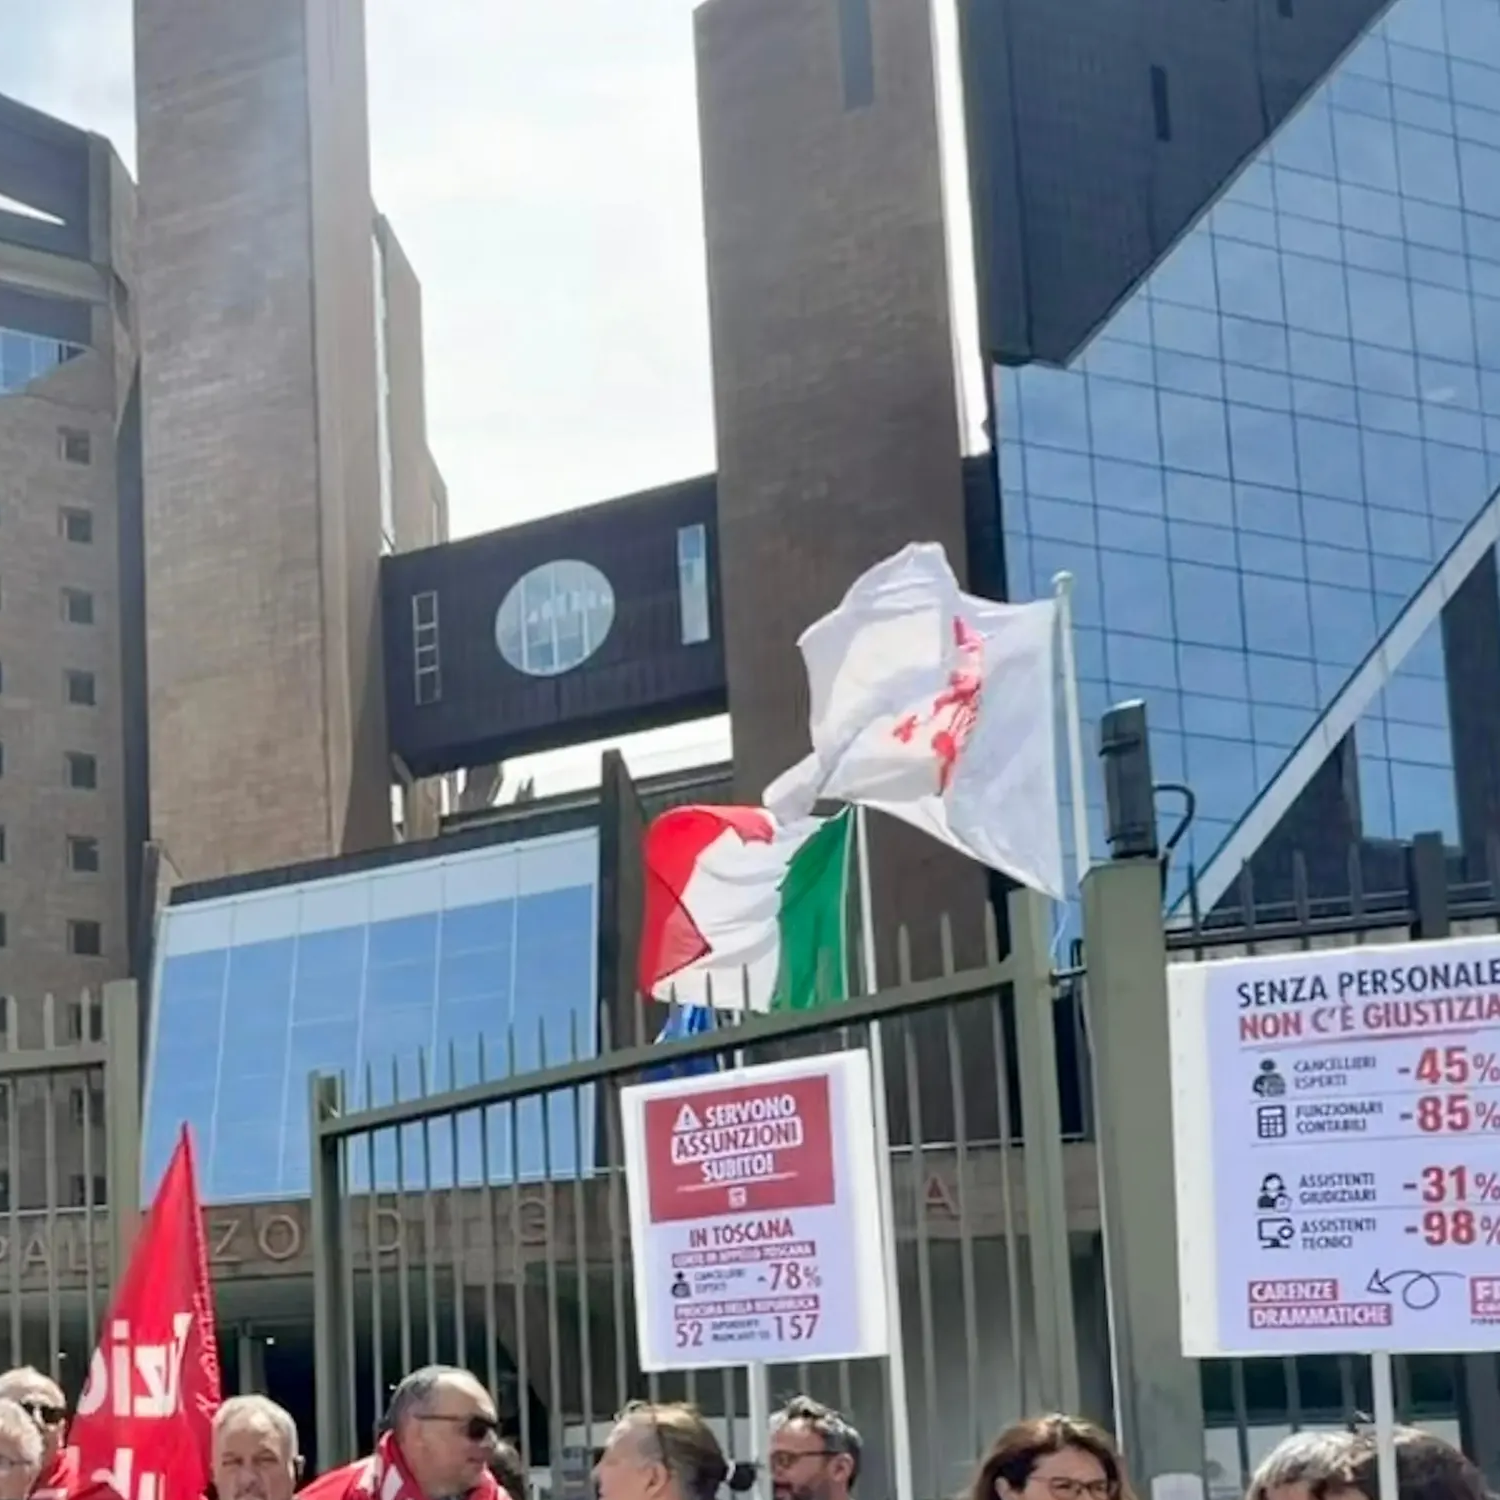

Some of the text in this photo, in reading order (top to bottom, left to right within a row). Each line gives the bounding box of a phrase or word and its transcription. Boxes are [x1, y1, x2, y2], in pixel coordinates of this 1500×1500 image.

[1237, 958, 1500, 1008] SENZA PERSONALE
[1239, 993, 1500, 1042] NON C'È GIUSTIZIA
[1398, 1046, 1500, 1084] -45%
[705, 1095, 795, 1127] SERVONO
[1296, 1101, 1383, 1119] FUNZIONARI
[1399, 1094, 1500, 1132] -85%
[676, 1121, 799, 1159] ASSUNZIONI
[1297, 1117, 1368, 1134] CONTABILI
[701, 1152, 773, 1182] SUBITO!
[1299, 1172, 1376, 1188] ASSISTENTI
[1403, 1165, 1500, 1203] -31%
[690, 1218, 794, 1248] IN TOSCANA
[1300, 1217, 1377, 1234] ASSISTENTI
[1404, 1209, 1500, 1246] -98%
[757, 1262, 822, 1291] -78%
[1252, 1281, 1335, 1301] CARENZE
[774, 1314, 818, 1341] 157
[1253, 1304, 1389, 1328] DRAMMATICHE
[676, 1322, 704, 1348] 52
